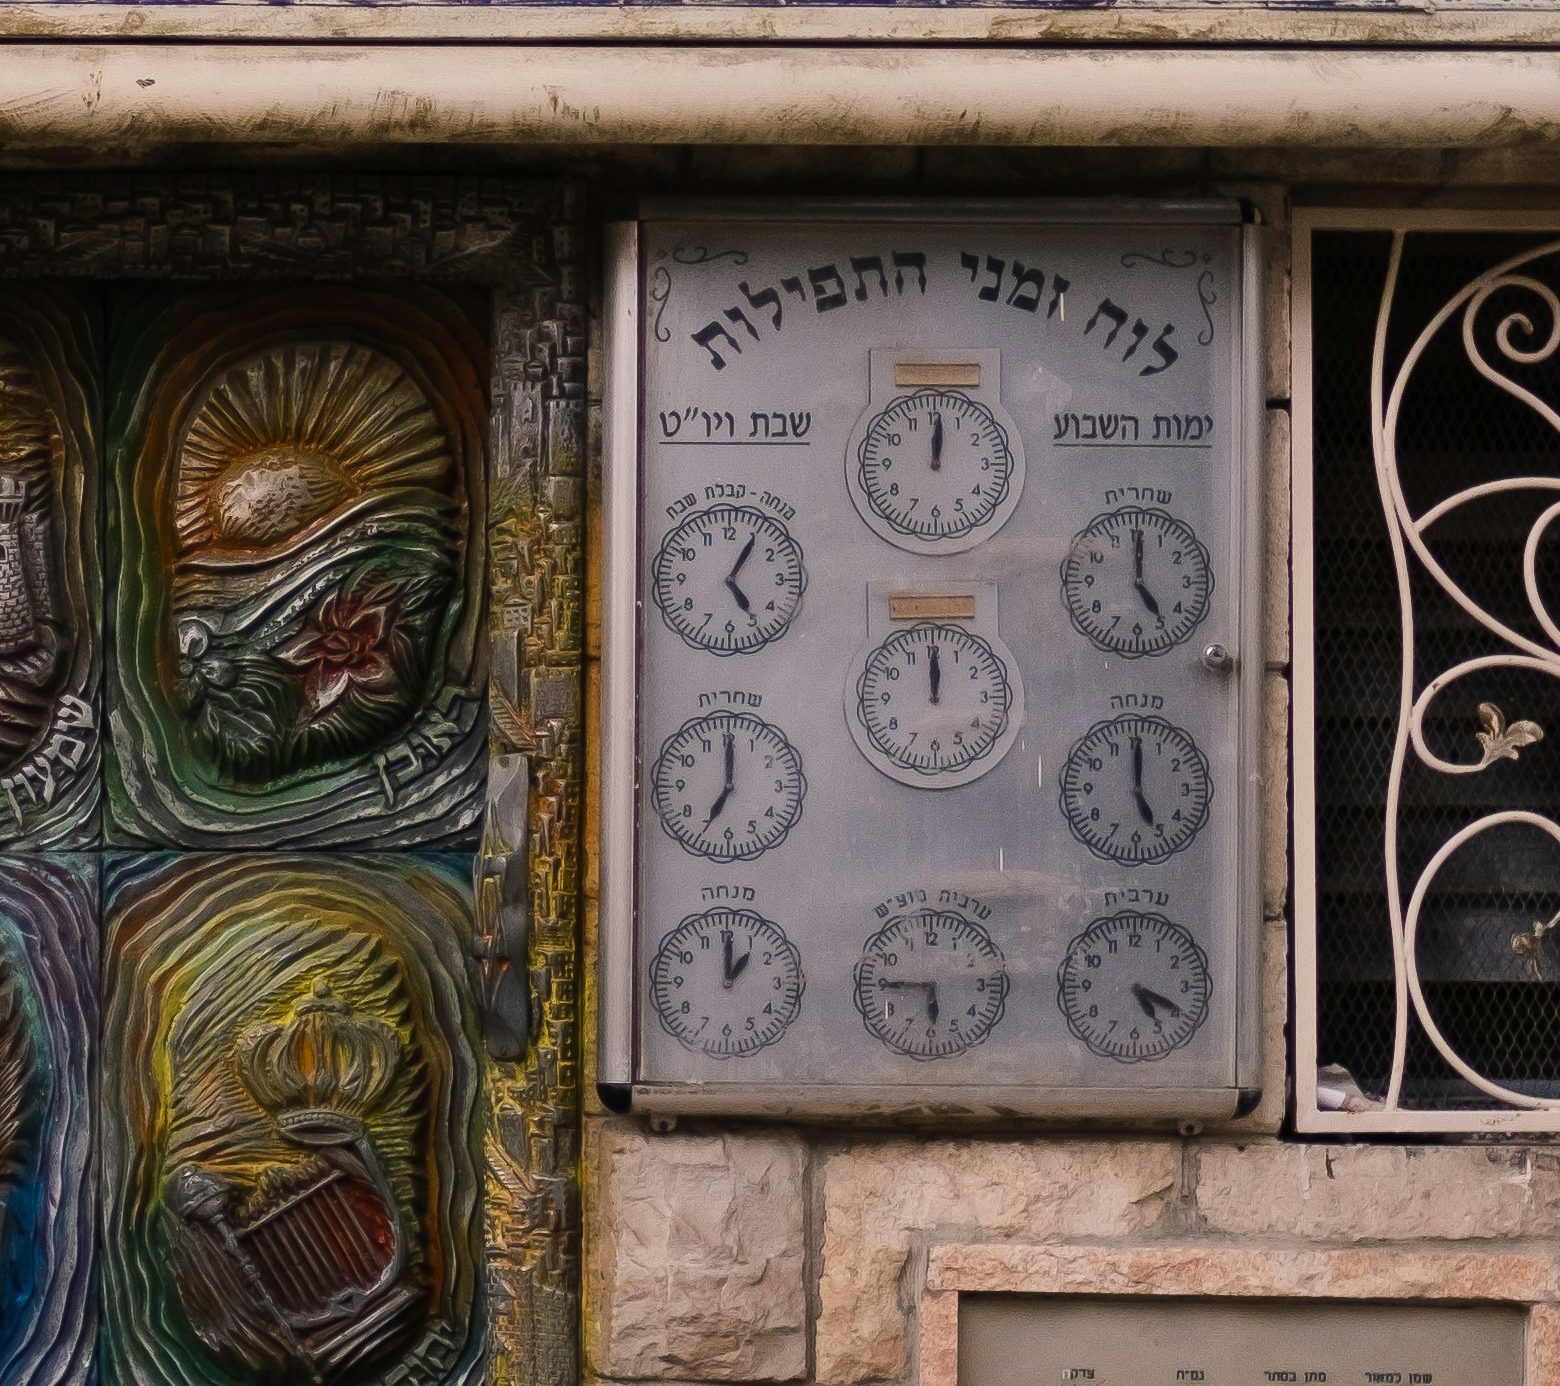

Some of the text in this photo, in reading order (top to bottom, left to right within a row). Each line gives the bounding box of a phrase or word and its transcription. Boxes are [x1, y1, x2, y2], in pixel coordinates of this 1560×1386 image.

[691, 250, 1178, 377] לוח זמני התפילות
[749, 412, 811, 438] שבת
[1053, 413, 1213, 441] ימות השבוע
[1105, 487, 1172, 505] שחרית
[698, 690, 762, 708] שחרית
[1110, 693, 1164, 710] מנחה
[1, 694, 94, 829] שמעון
[701, 885, 756, 901] מנחה
[1104, 889, 1169, 907] ערבית
[1409, 1372, 1432, 1384] שמן
